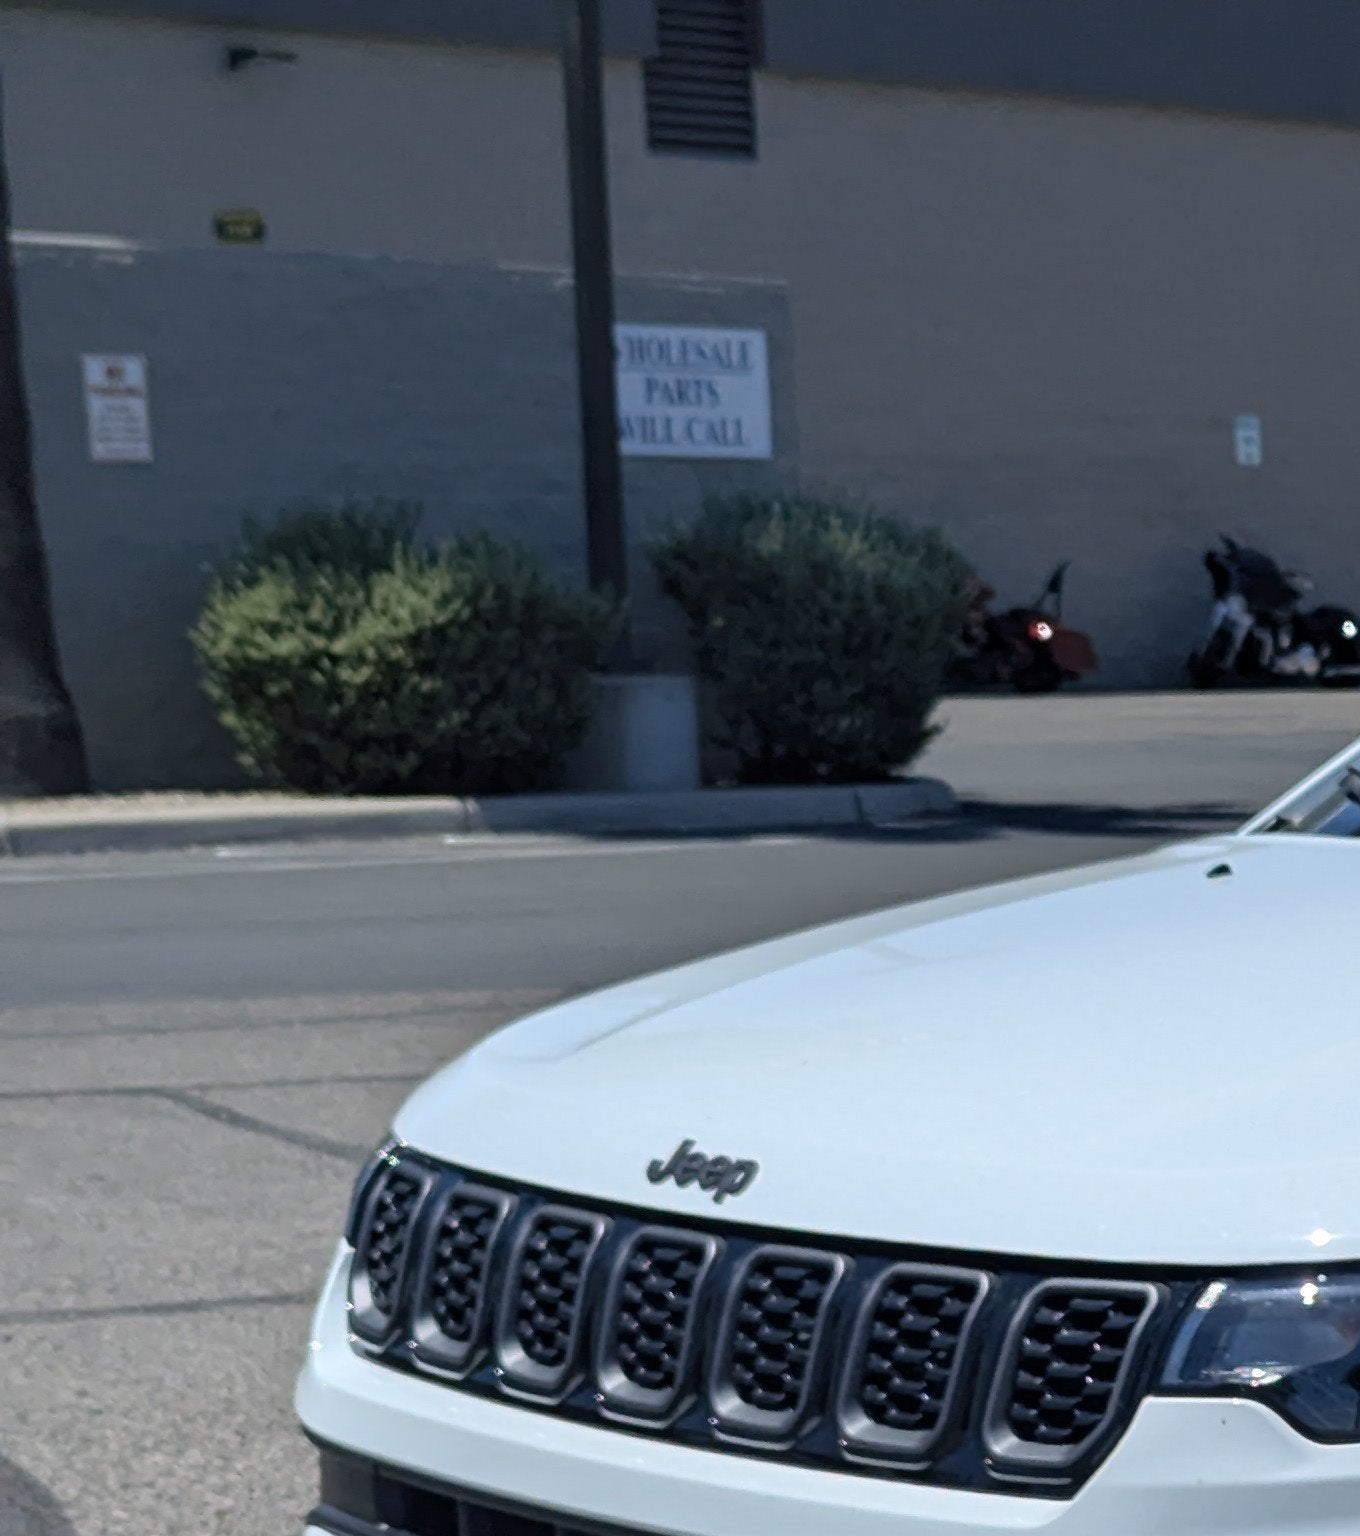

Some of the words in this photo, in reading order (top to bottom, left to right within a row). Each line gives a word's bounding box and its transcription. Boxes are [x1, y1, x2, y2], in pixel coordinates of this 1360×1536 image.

[617, 335, 755, 369] HOLESALE
[645, 377, 721, 406] PARTS
[681, 416, 749, 447] CALL
[646, 1138, 760, 1205] Jeep
